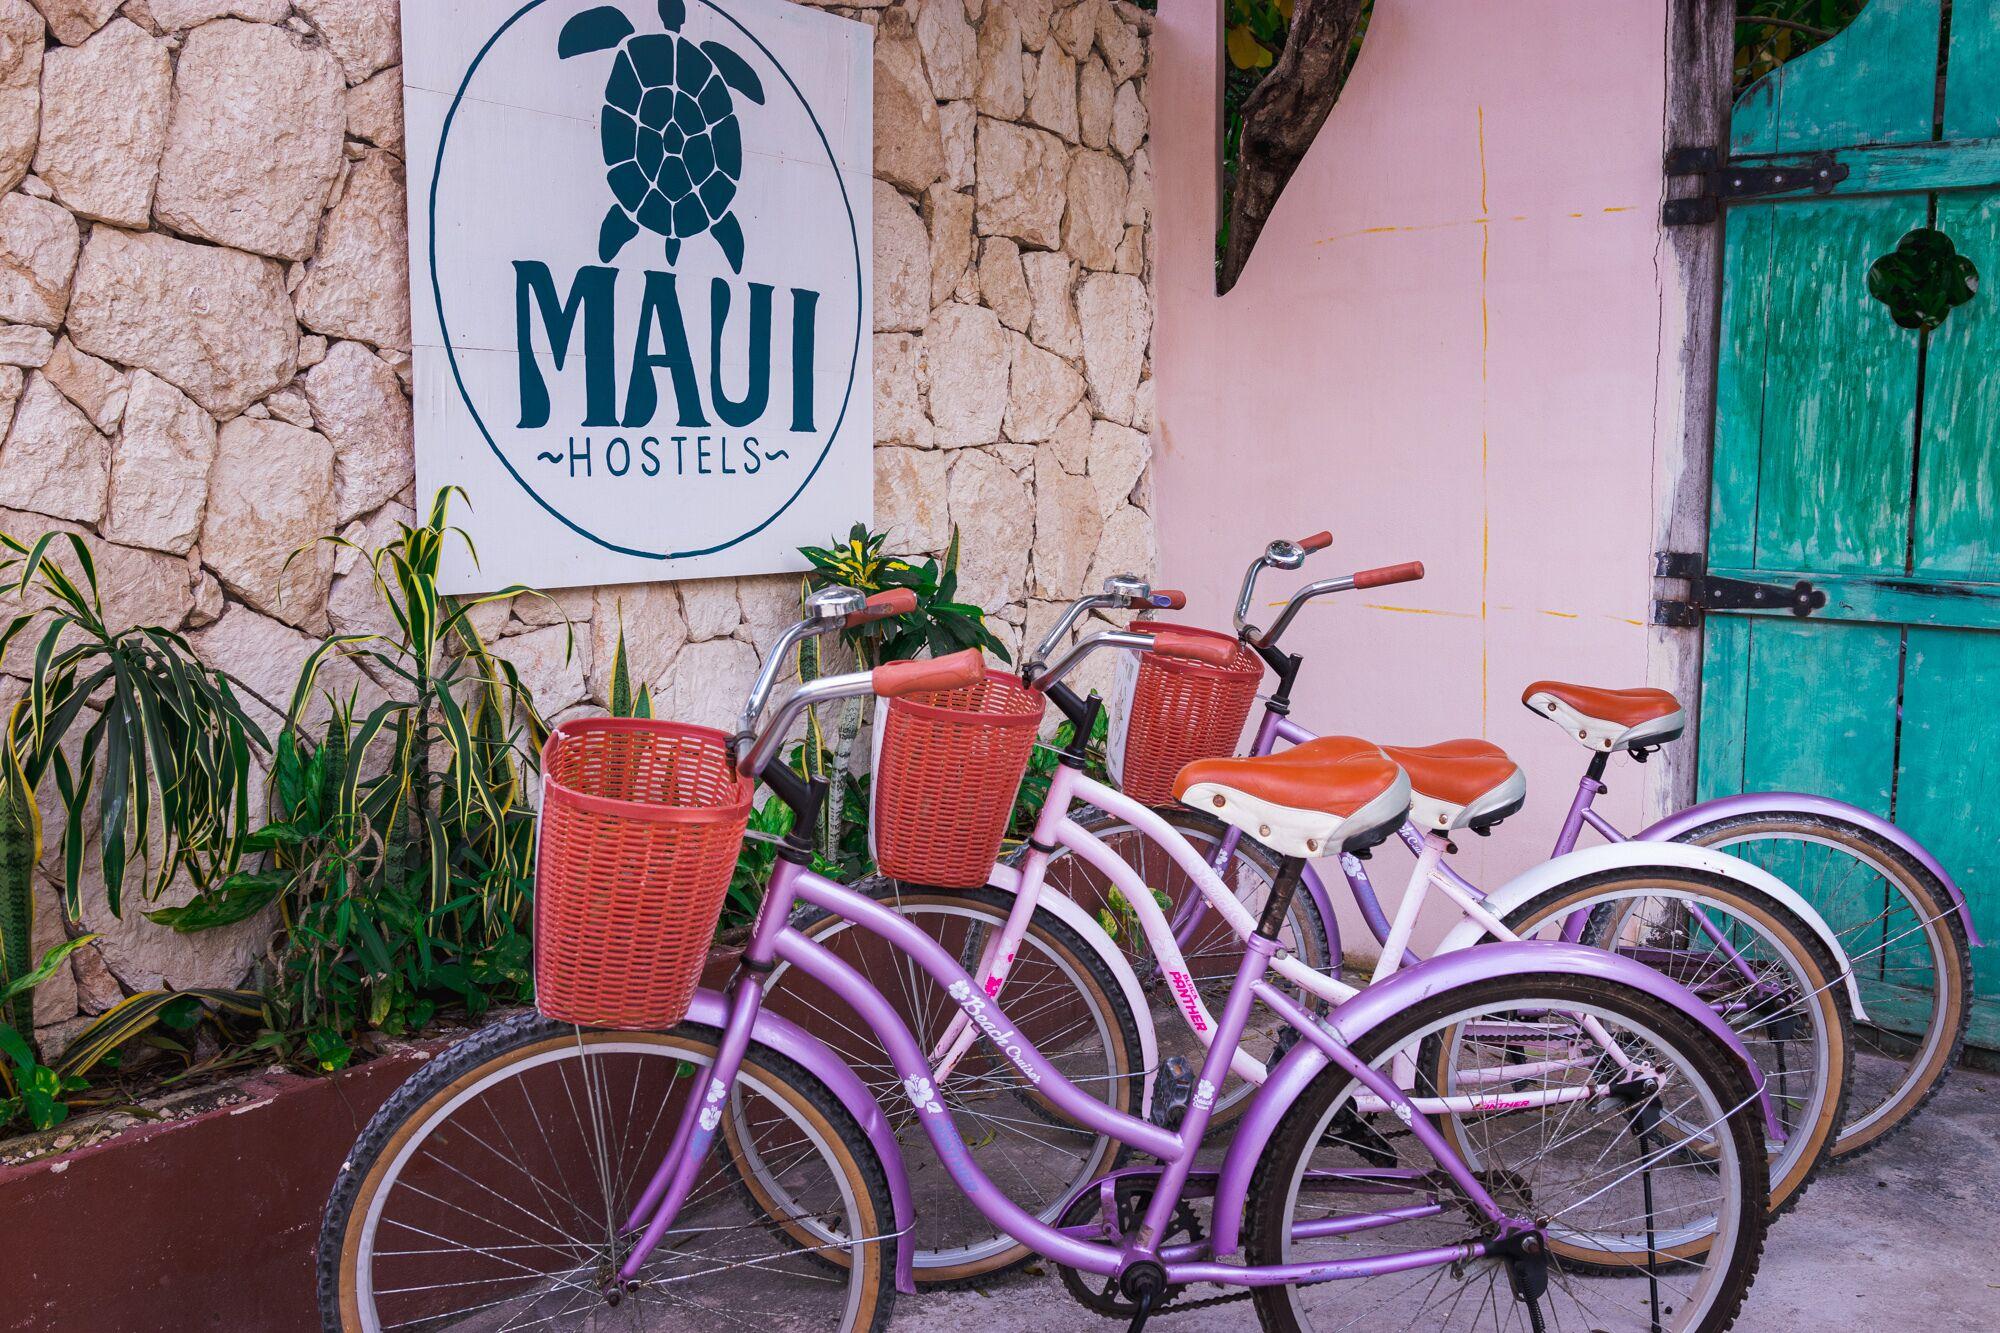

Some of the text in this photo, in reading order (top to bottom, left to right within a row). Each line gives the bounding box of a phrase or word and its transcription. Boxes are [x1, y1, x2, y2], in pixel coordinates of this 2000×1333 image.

[511, 260, 821, 433] MAUI
[1168, 971, 1208, 1032] PANTHER
[1182, 973, 1199, 1000] BLACK
[961, 995, 1041, 1084] Beach Cruiser
